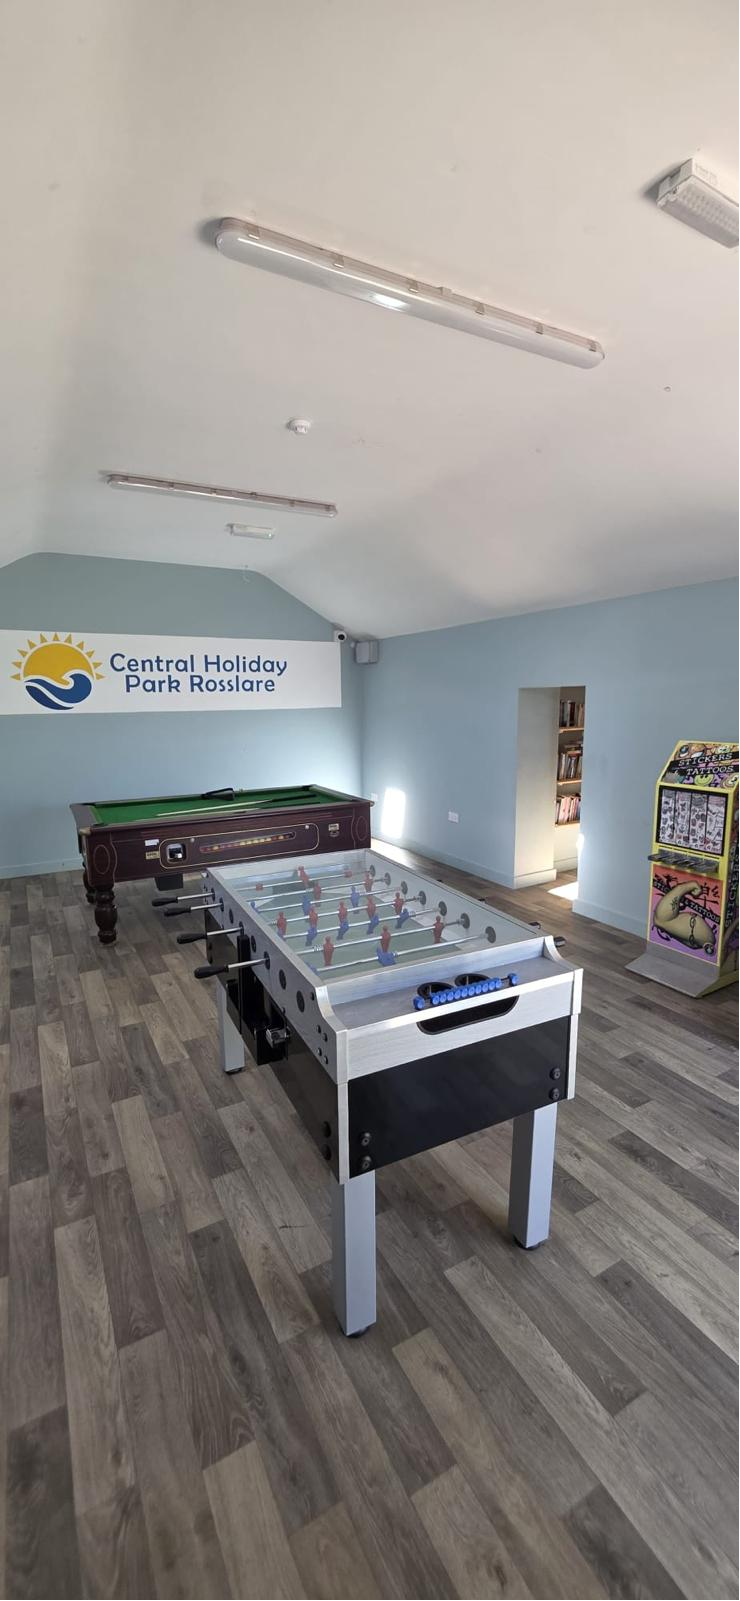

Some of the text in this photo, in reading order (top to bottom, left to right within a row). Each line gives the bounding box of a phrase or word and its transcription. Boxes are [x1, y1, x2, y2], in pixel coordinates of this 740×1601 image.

[110, 653, 288, 676] Central Holiday
[125, 674, 275, 693] Park Rosslare
[678, 753, 733, 766] STICKERS
[686, 766, 734, 776] TATTOOS
[690, 902, 720, 922] TATTOOS
